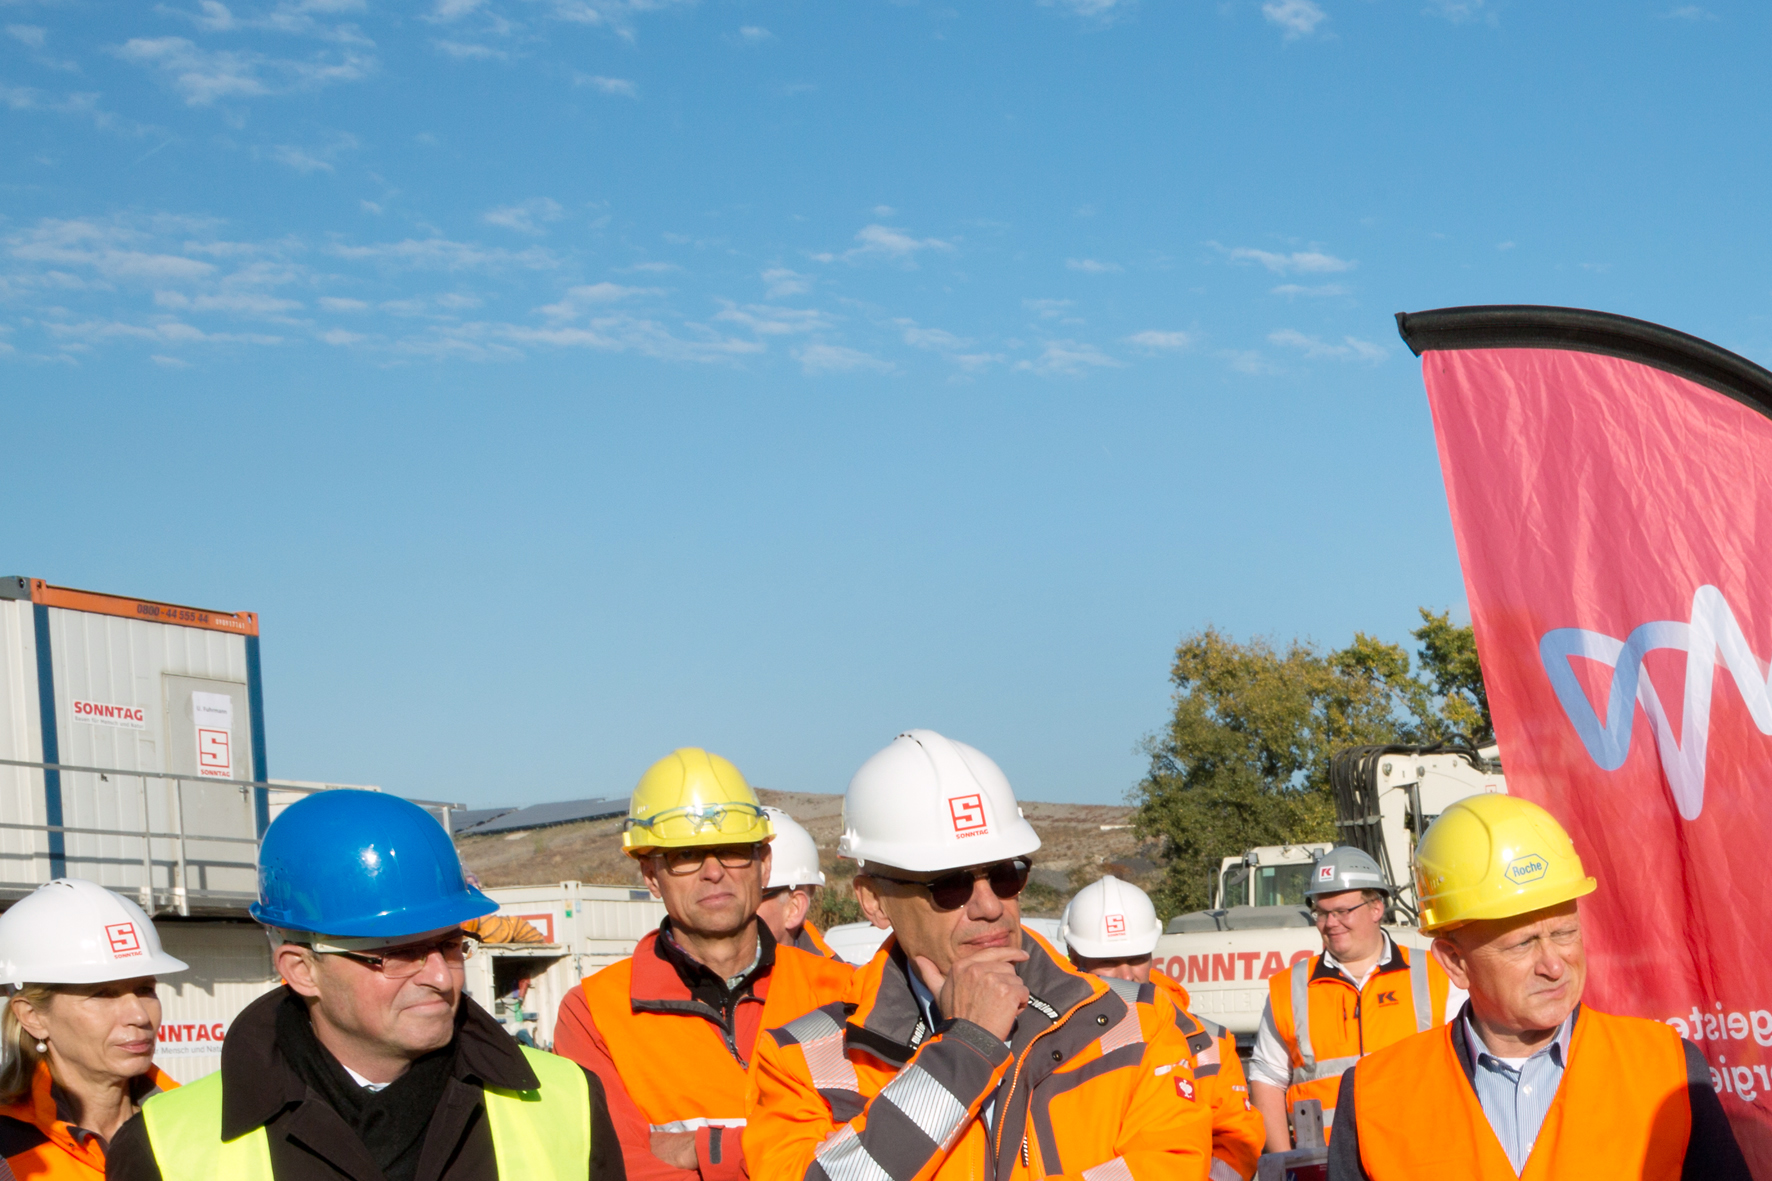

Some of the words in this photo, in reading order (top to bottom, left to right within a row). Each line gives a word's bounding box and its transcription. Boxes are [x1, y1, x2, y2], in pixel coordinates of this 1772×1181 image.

[137, 604, 160, 617] 0800
[166, 608, 177, 619] 44
[179, 610, 196, 622] 555
[197, 613, 209, 624] 44
[74, 701, 144, 722] SONNTAG
[200, 769, 231, 778] SONNTAG
[955, 828, 989, 840] SONNTAG
[1512, 861, 1543, 878] Roche
[114, 950, 143, 959] SONNTAG
[157, 1023, 225, 1043] NNTAG
[161, 1046, 189, 1055] Mensch
[191, 1046, 204, 1054] und
